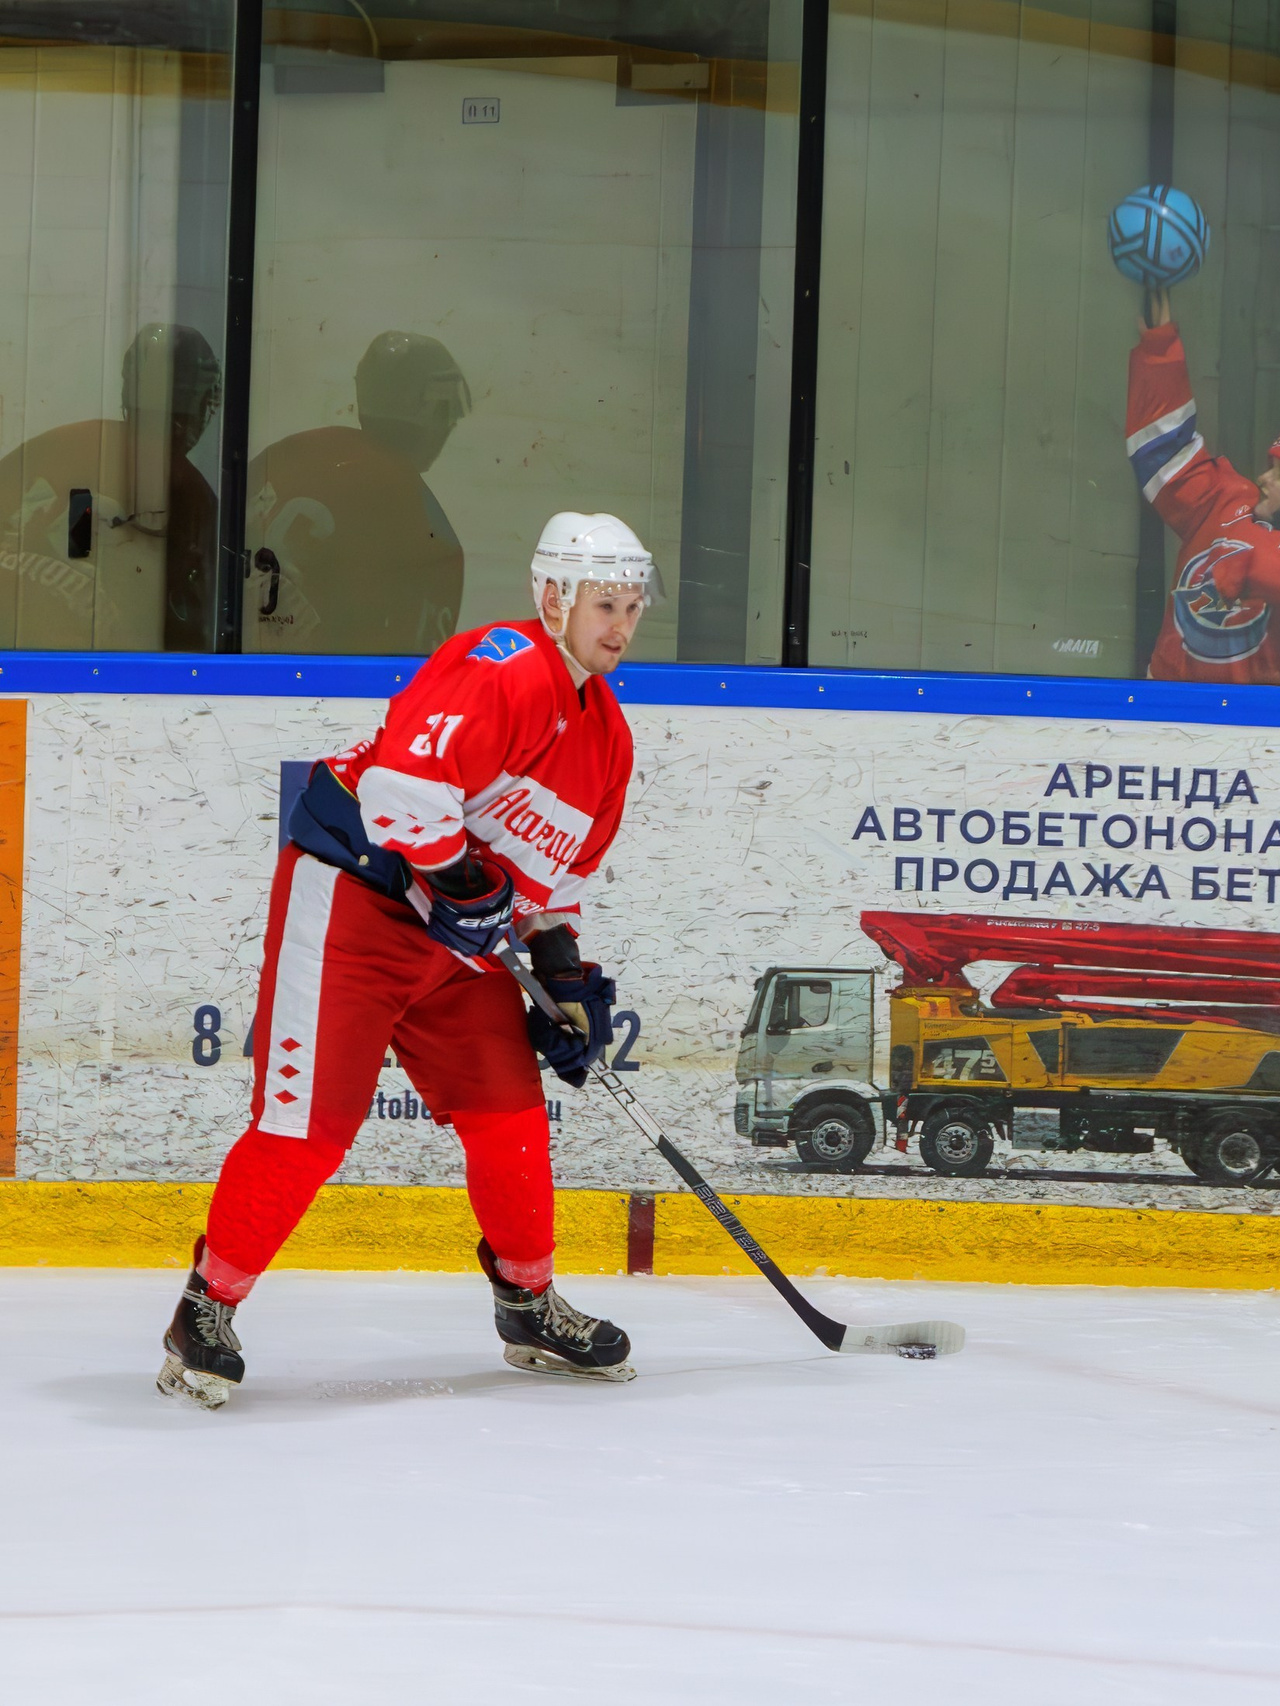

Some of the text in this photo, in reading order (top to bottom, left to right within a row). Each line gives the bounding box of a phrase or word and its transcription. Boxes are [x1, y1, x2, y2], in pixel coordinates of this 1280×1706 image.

[408, 712, 464, 759] 21
[1046, 764, 1260, 811] АРЕНДА
[895, 857, 1170, 903] ПРОДАЖА
[192, 1005, 222, 1066] 8
